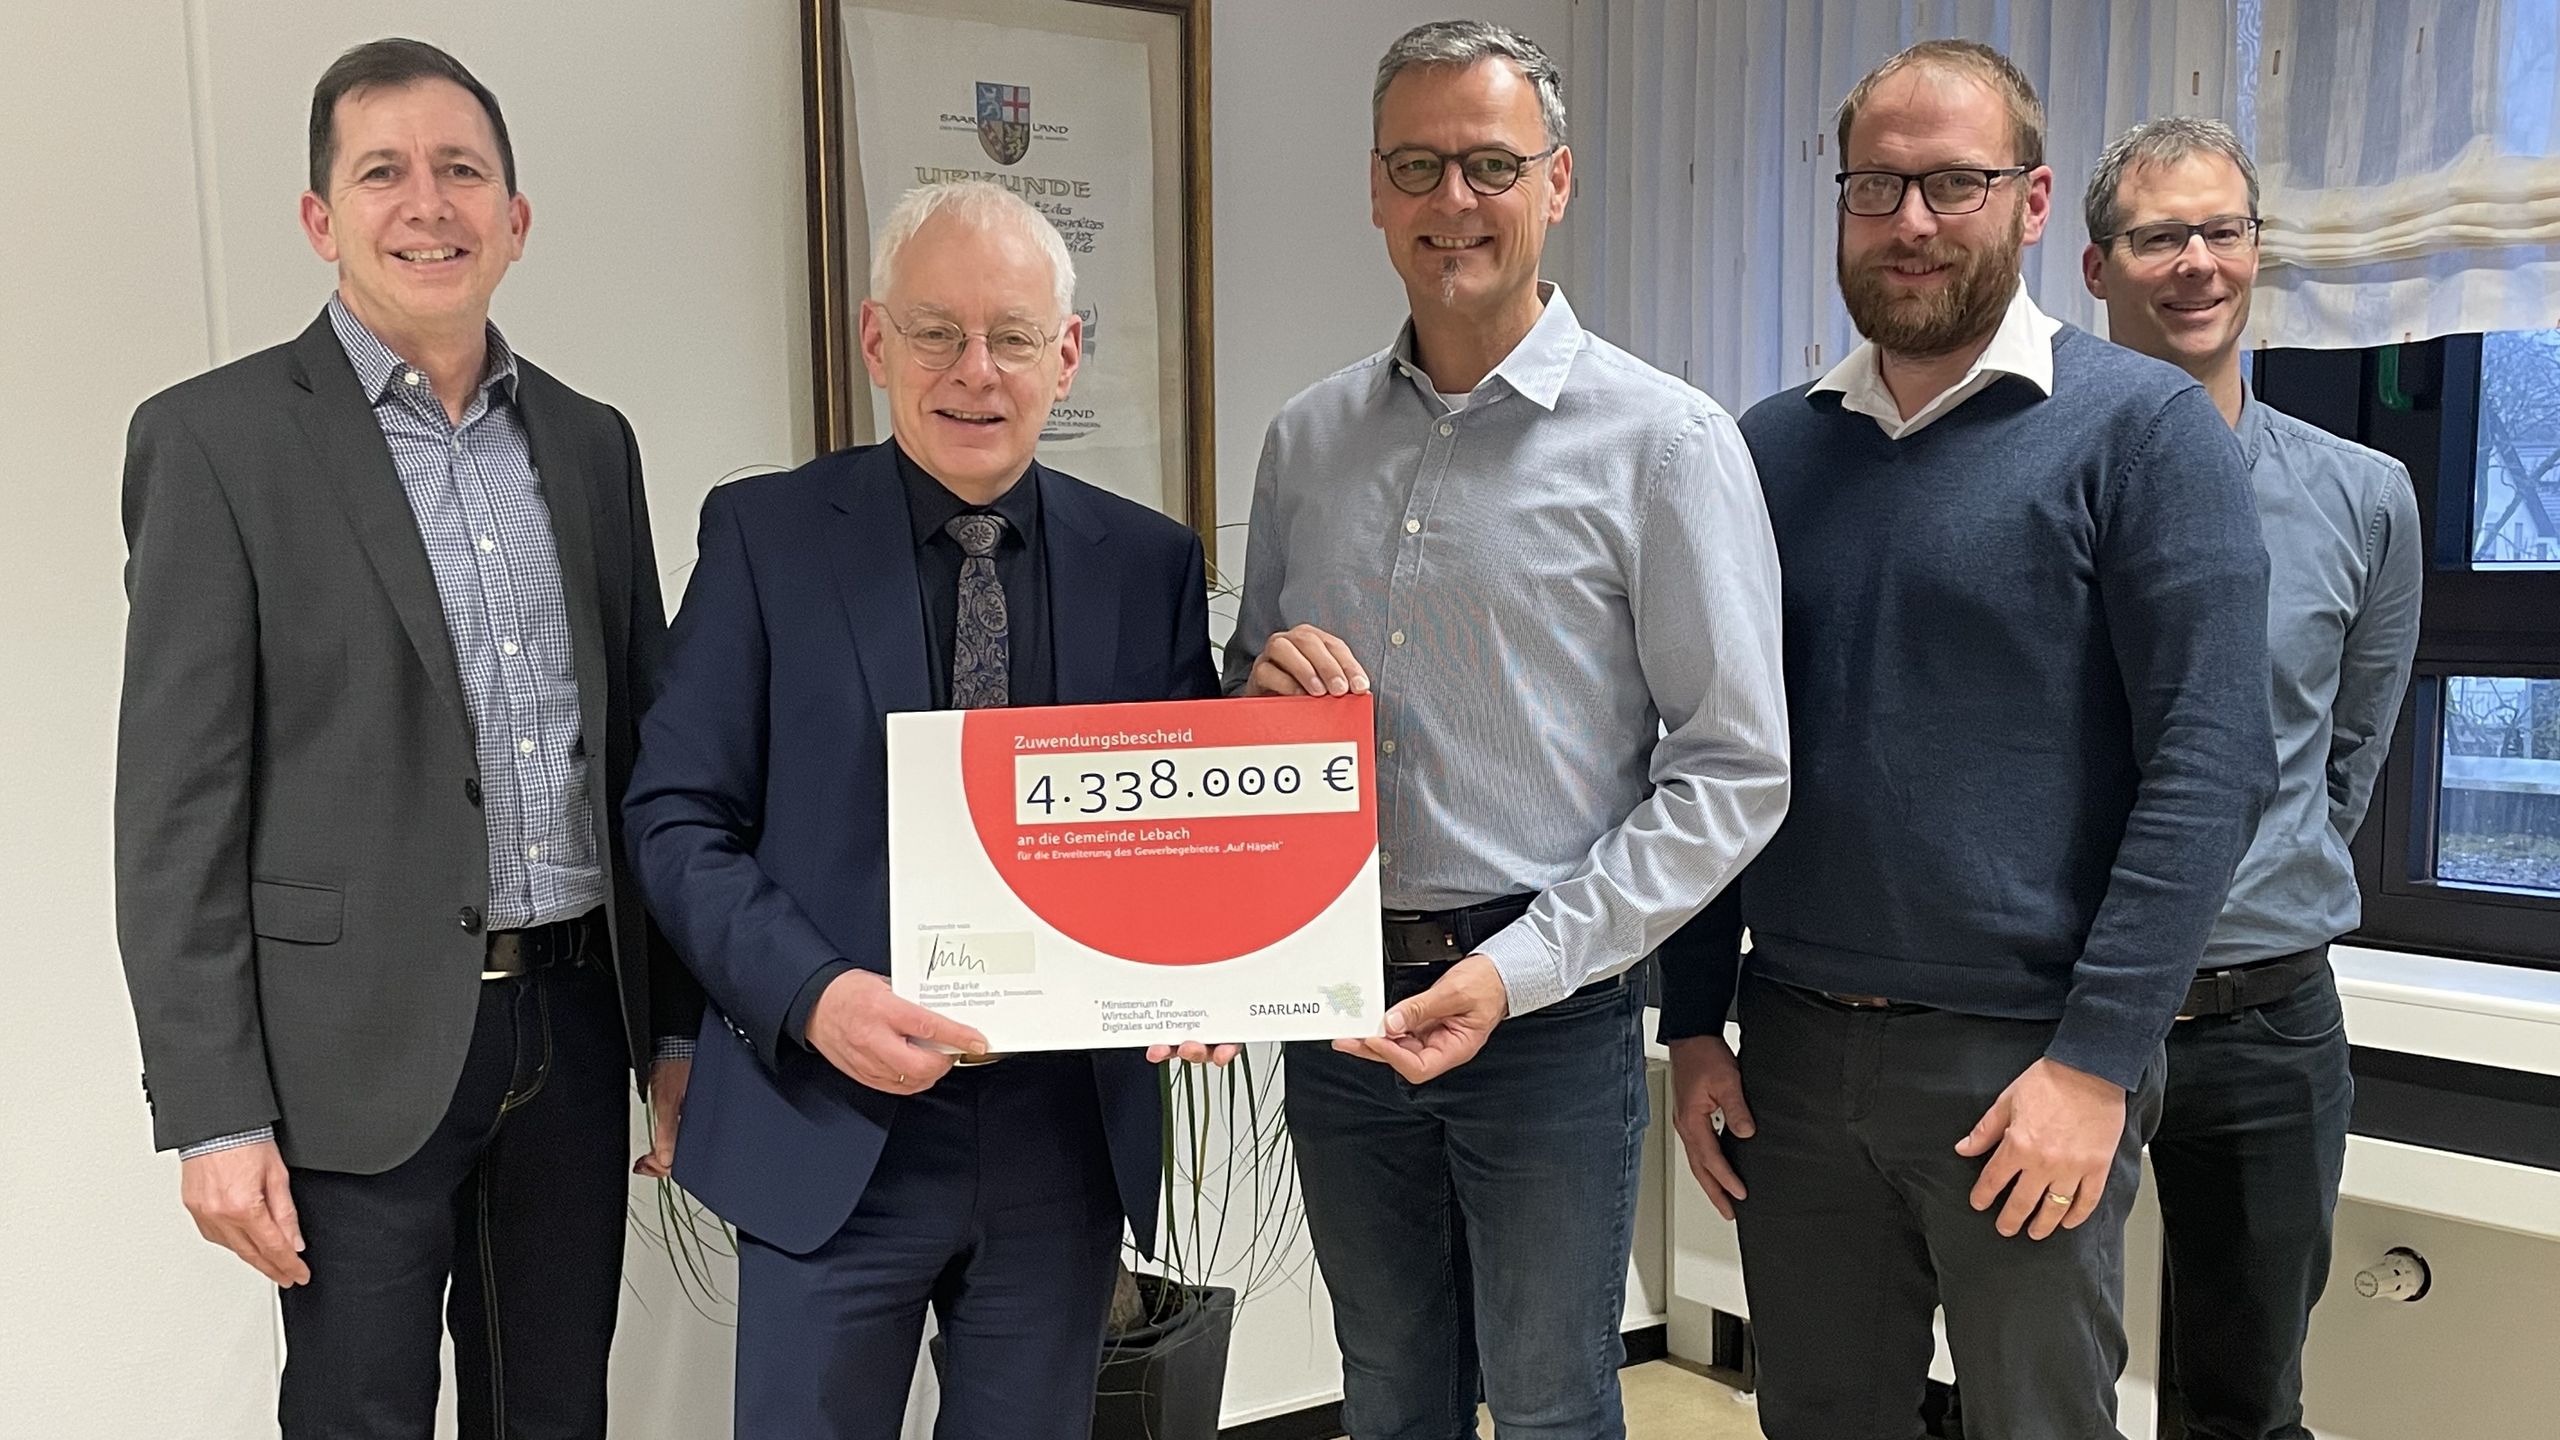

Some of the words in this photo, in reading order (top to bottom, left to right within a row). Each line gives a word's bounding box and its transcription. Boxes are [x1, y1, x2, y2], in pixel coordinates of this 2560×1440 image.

[1032, 123, 1069, 134] LAND
[1015, 729, 1193, 750] Zuwendungsbescheid
[1026, 759, 1301, 815] 4.338.000
[1323, 755, 1354, 792] €
[1017, 834, 1034, 846] an
[1039, 831, 1060, 845] die
[1064, 828, 1136, 844] Gemeinde
[1140, 827, 1190, 841] Lebach
[1017, 850, 1032, 861] für
[1034, 850, 1050, 861] die
[1052, 848, 1112, 860] Erweiterung
[1114, 847, 1132, 857] des
[1134, 843, 1220, 857] Gewerbegebietes
[919, 982, 951, 993] Jürgen
[952, 981, 980, 991] Barke
[1101, 1000, 1158, 1010] Ministerium
[1160, 998, 1174, 1008] für
[1249, 1002, 1321, 1017] SAARLAND
[1101, 1010, 1154, 1021] Wirtschaft,
[1156, 1009, 1208, 1019] Innovation,
[1102, 1022, 1142, 1034] Digitales
[1144, 1020, 1163, 1030] und
[1165, 1020, 1201, 1031] Energie
